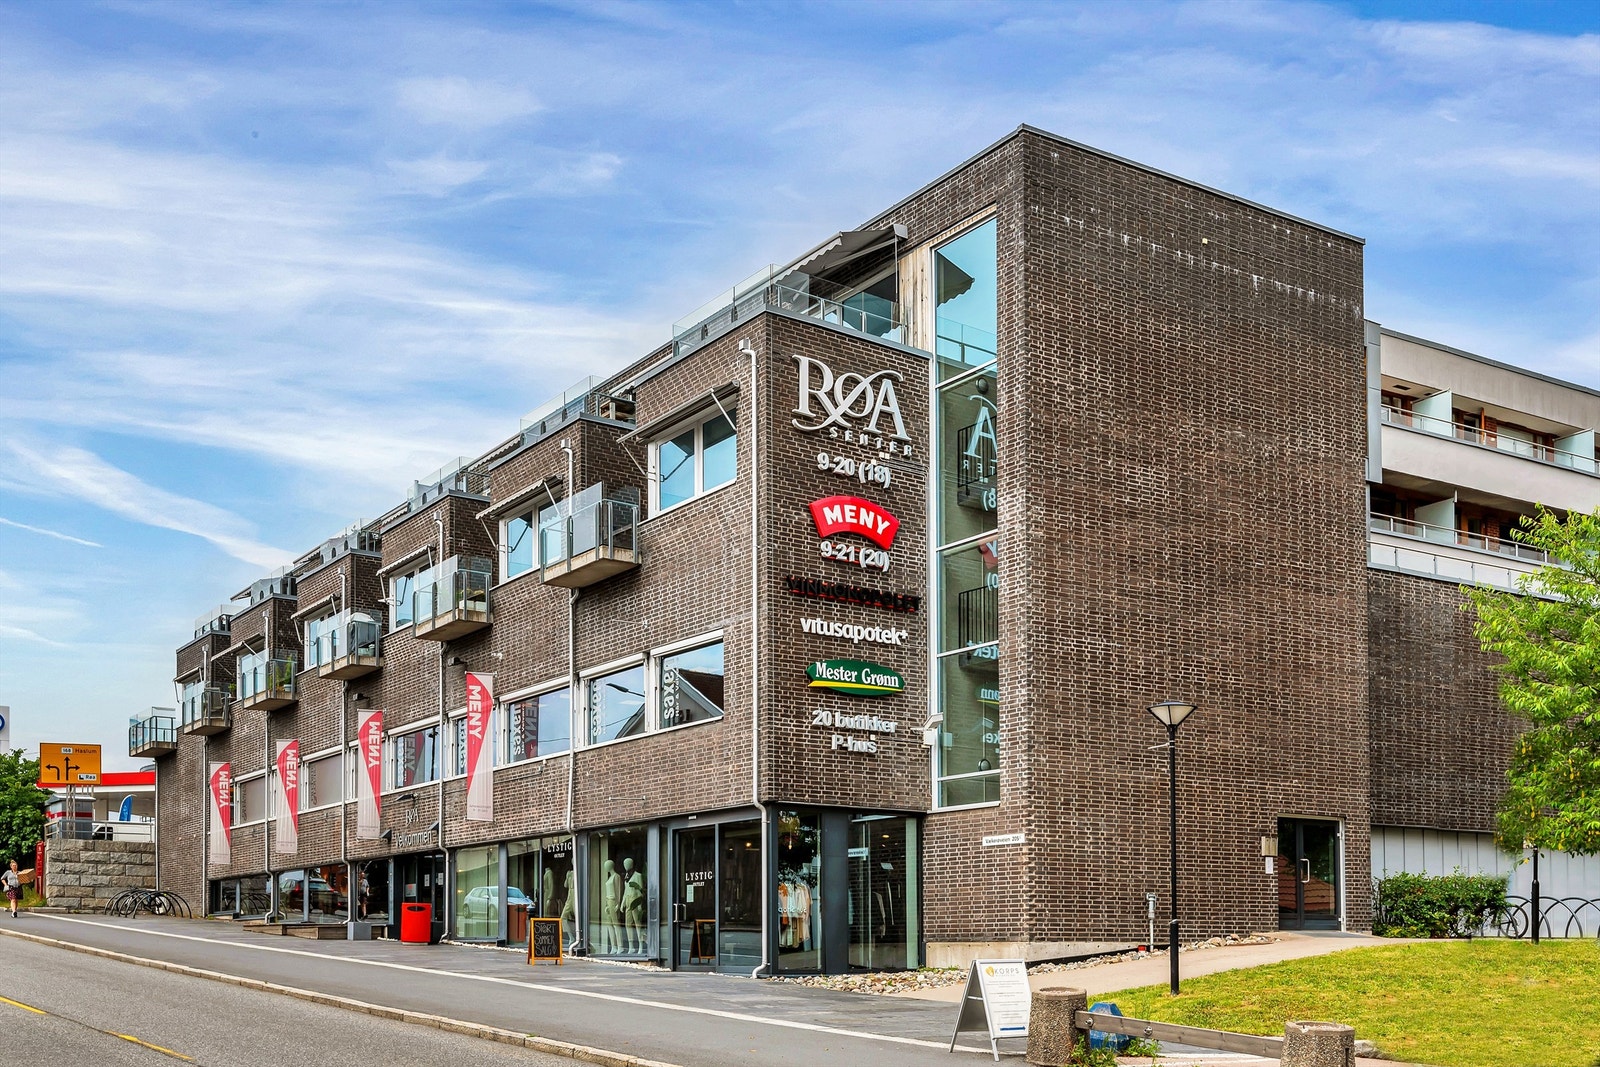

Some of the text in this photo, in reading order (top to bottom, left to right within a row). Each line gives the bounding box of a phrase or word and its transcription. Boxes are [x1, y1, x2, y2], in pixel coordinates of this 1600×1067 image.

[792, 354, 912, 440] RØA
[829, 426, 913, 457] SENTER
[817, 452, 891, 489] 9-20 (18)
[823, 504, 890, 535] MENY
[820, 540, 890, 573] 9-21 (20)
[815, 661, 899, 687] Mester Grønn
[468, 685, 482, 740] MENY
[812, 709, 898, 733] 20 butikker
[831, 734, 877, 753] P-hus
